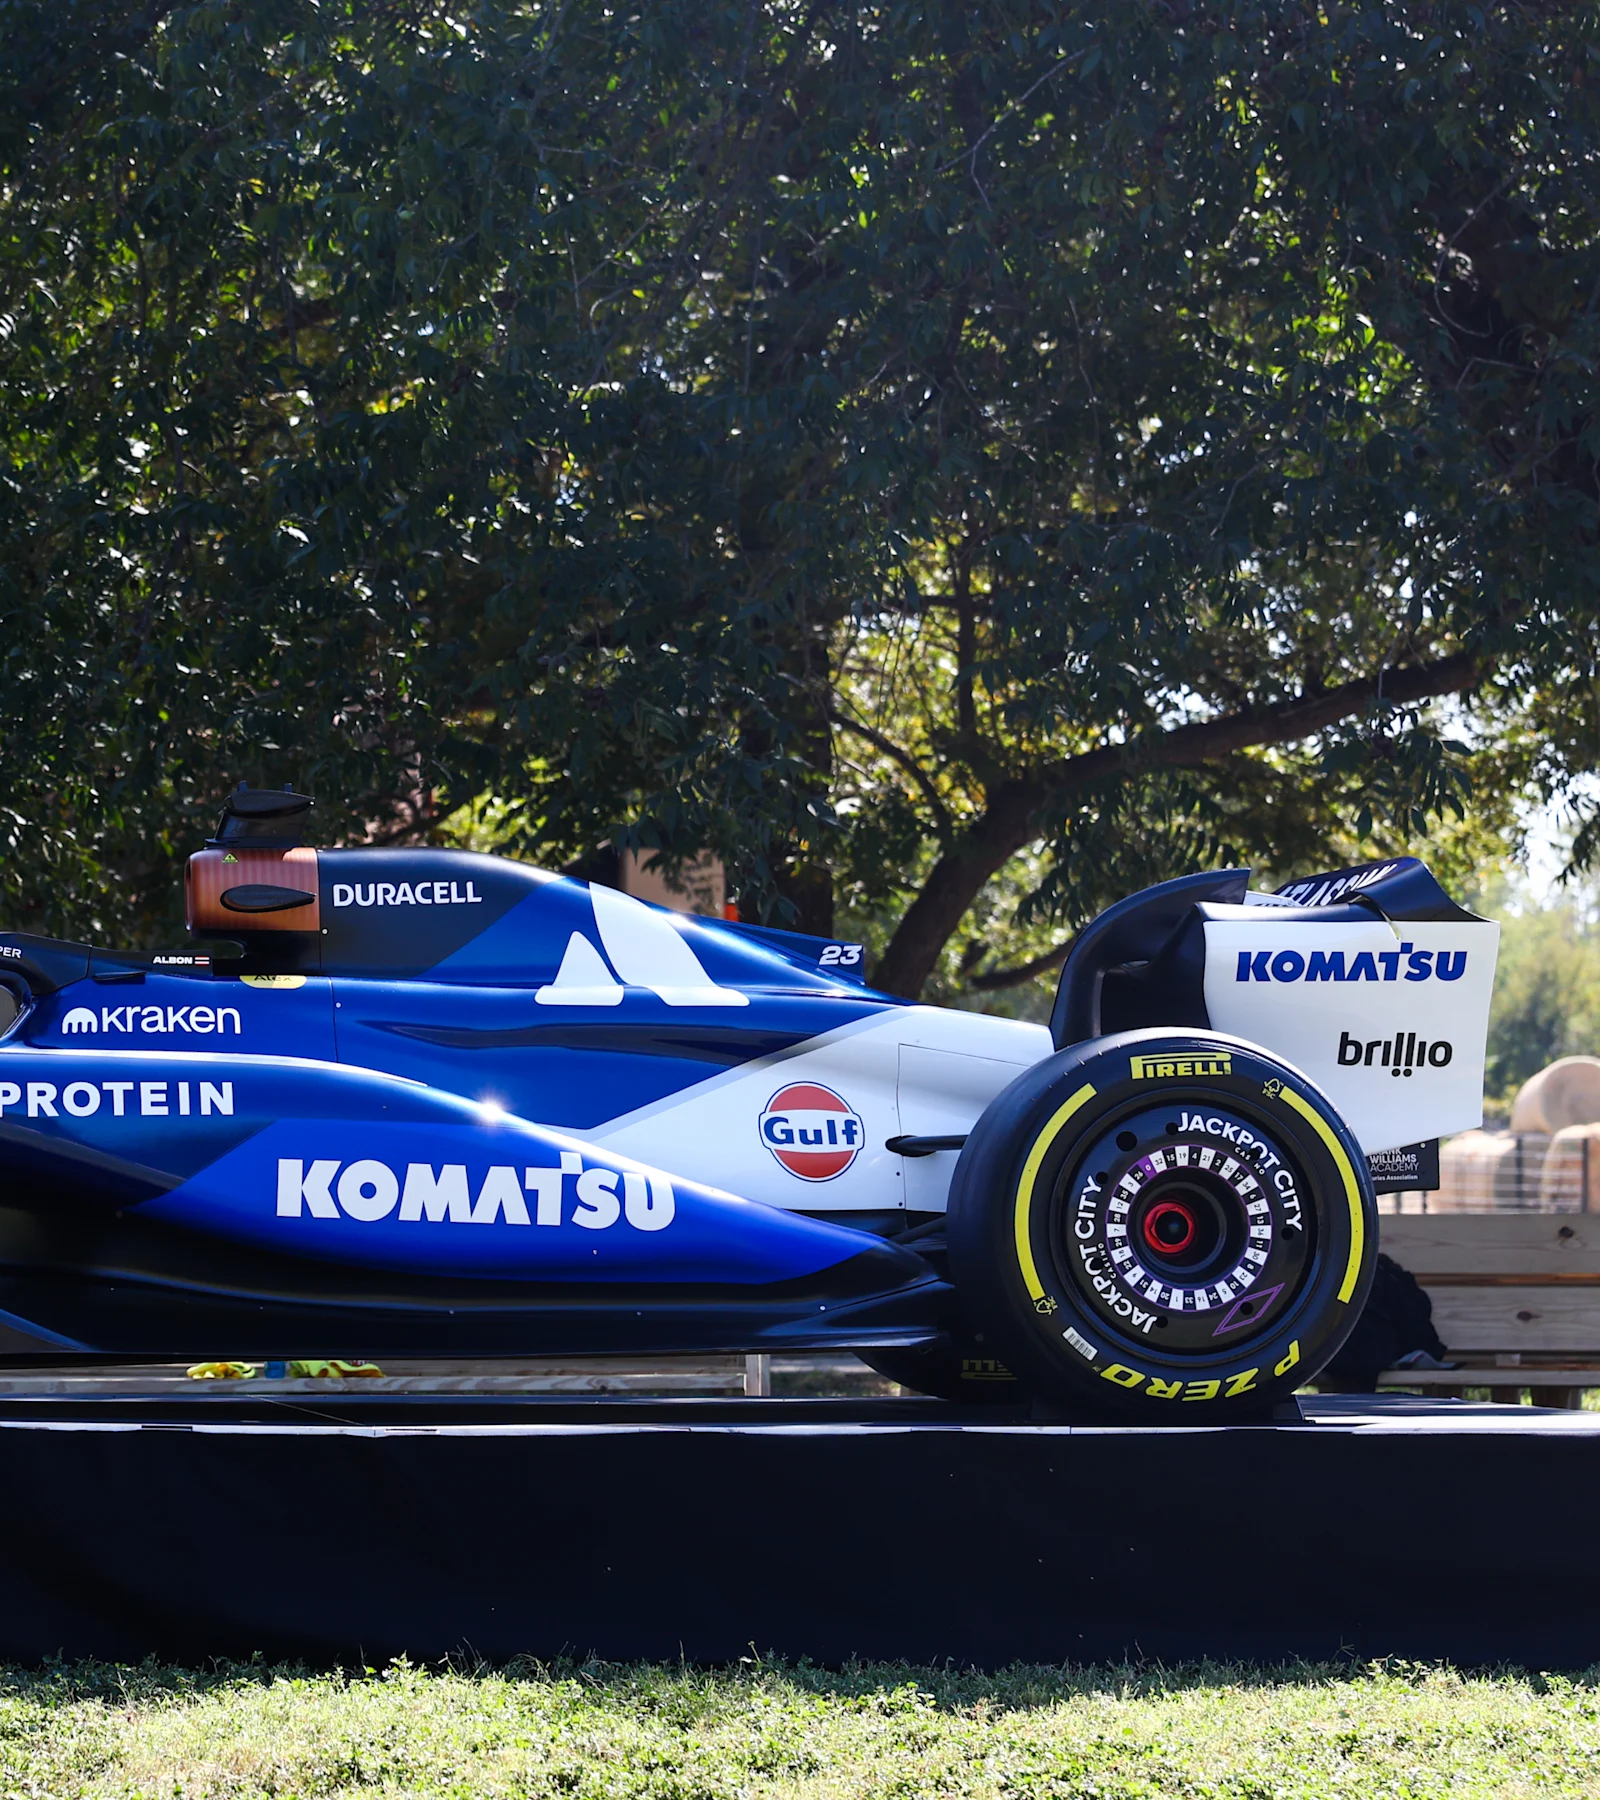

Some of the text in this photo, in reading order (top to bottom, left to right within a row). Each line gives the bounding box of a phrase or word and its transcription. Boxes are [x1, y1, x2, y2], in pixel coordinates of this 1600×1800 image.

[332, 880, 482, 908] DURACELL
[152, 956, 193, 965] ALBON
[818, 945, 863, 966] 23
[1235, 942, 1468, 983] KOMATSU
[102, 1005, 241, 1035] kraken
[1337, 1031, 1453, 1077] brillio
[1129, 1052, 1232, 1080] PIRELLI
[763, 1116, 858, 1146] Gulf
[1166, 1153, 1176, 1162] 15
[1191, 1152, 1198, 1160] 4
[1201, 1154, 1211, 1162] 21
[1234, 1146, 1266, 1176] CASNO
[1369, 1153, 1417, 1164] WILLIAMS
[1154, 1157, 1164, 1166] 32
[1214, 1158, 1222, 1167] 2
[1177, 1111, 1303, 1231] JACKPOT CITY
[1223, 1164, 1234, 1174] 25
[1369, 1162, 1420, 1173] ACADEMY
[1134, 1170, 1144, 1181] 26
[1234, 1171, 1244, 1181] 17
[1386, 1173, 1419, 1181] Association
[1242, 1181, 1252, 1191] 34
[276, 1150, 676, 1233] KOMATSU
[1119, 1189, 1129, 1200] 35
[1116, 1201, 1124, 1210] 12
[1253, 1203, 1262, 1212] 27
[1113, 1213, 1121, 1223] 28
[1256, 1215, 1265, 1225] 13
[1257, 1227, 1265, 1237] 36
[1114, 1238, 1123, 1247] 29
[1255, 1240, 1264, 1249] 11
[1074, 1174, 1157, 1334] JACKPOT CITY
[1118, 1249, 1125, 1258] 18
[1251, 1250, 1261, 1261] 30
[1097, 1242, 1117, 1279] CASINO
[1123, 1259, 1133, 1270] 22
[1238, 1271, 1248, 1281] 23
[1139, 1279, 1149, 1289] 31
[1229, 1280, 1240, 1290] 10
[1149, 1286, 1158, 1295] 14
[1160, 1291, 1170, 1301] 20
[1175, 1295, 1179, 1303] 1
[1184, 1296, 1194, 1304] 33
[1208, 1291, 1219, 1301] 24
[1100, 1339, 1300, 1402] P ZERO
